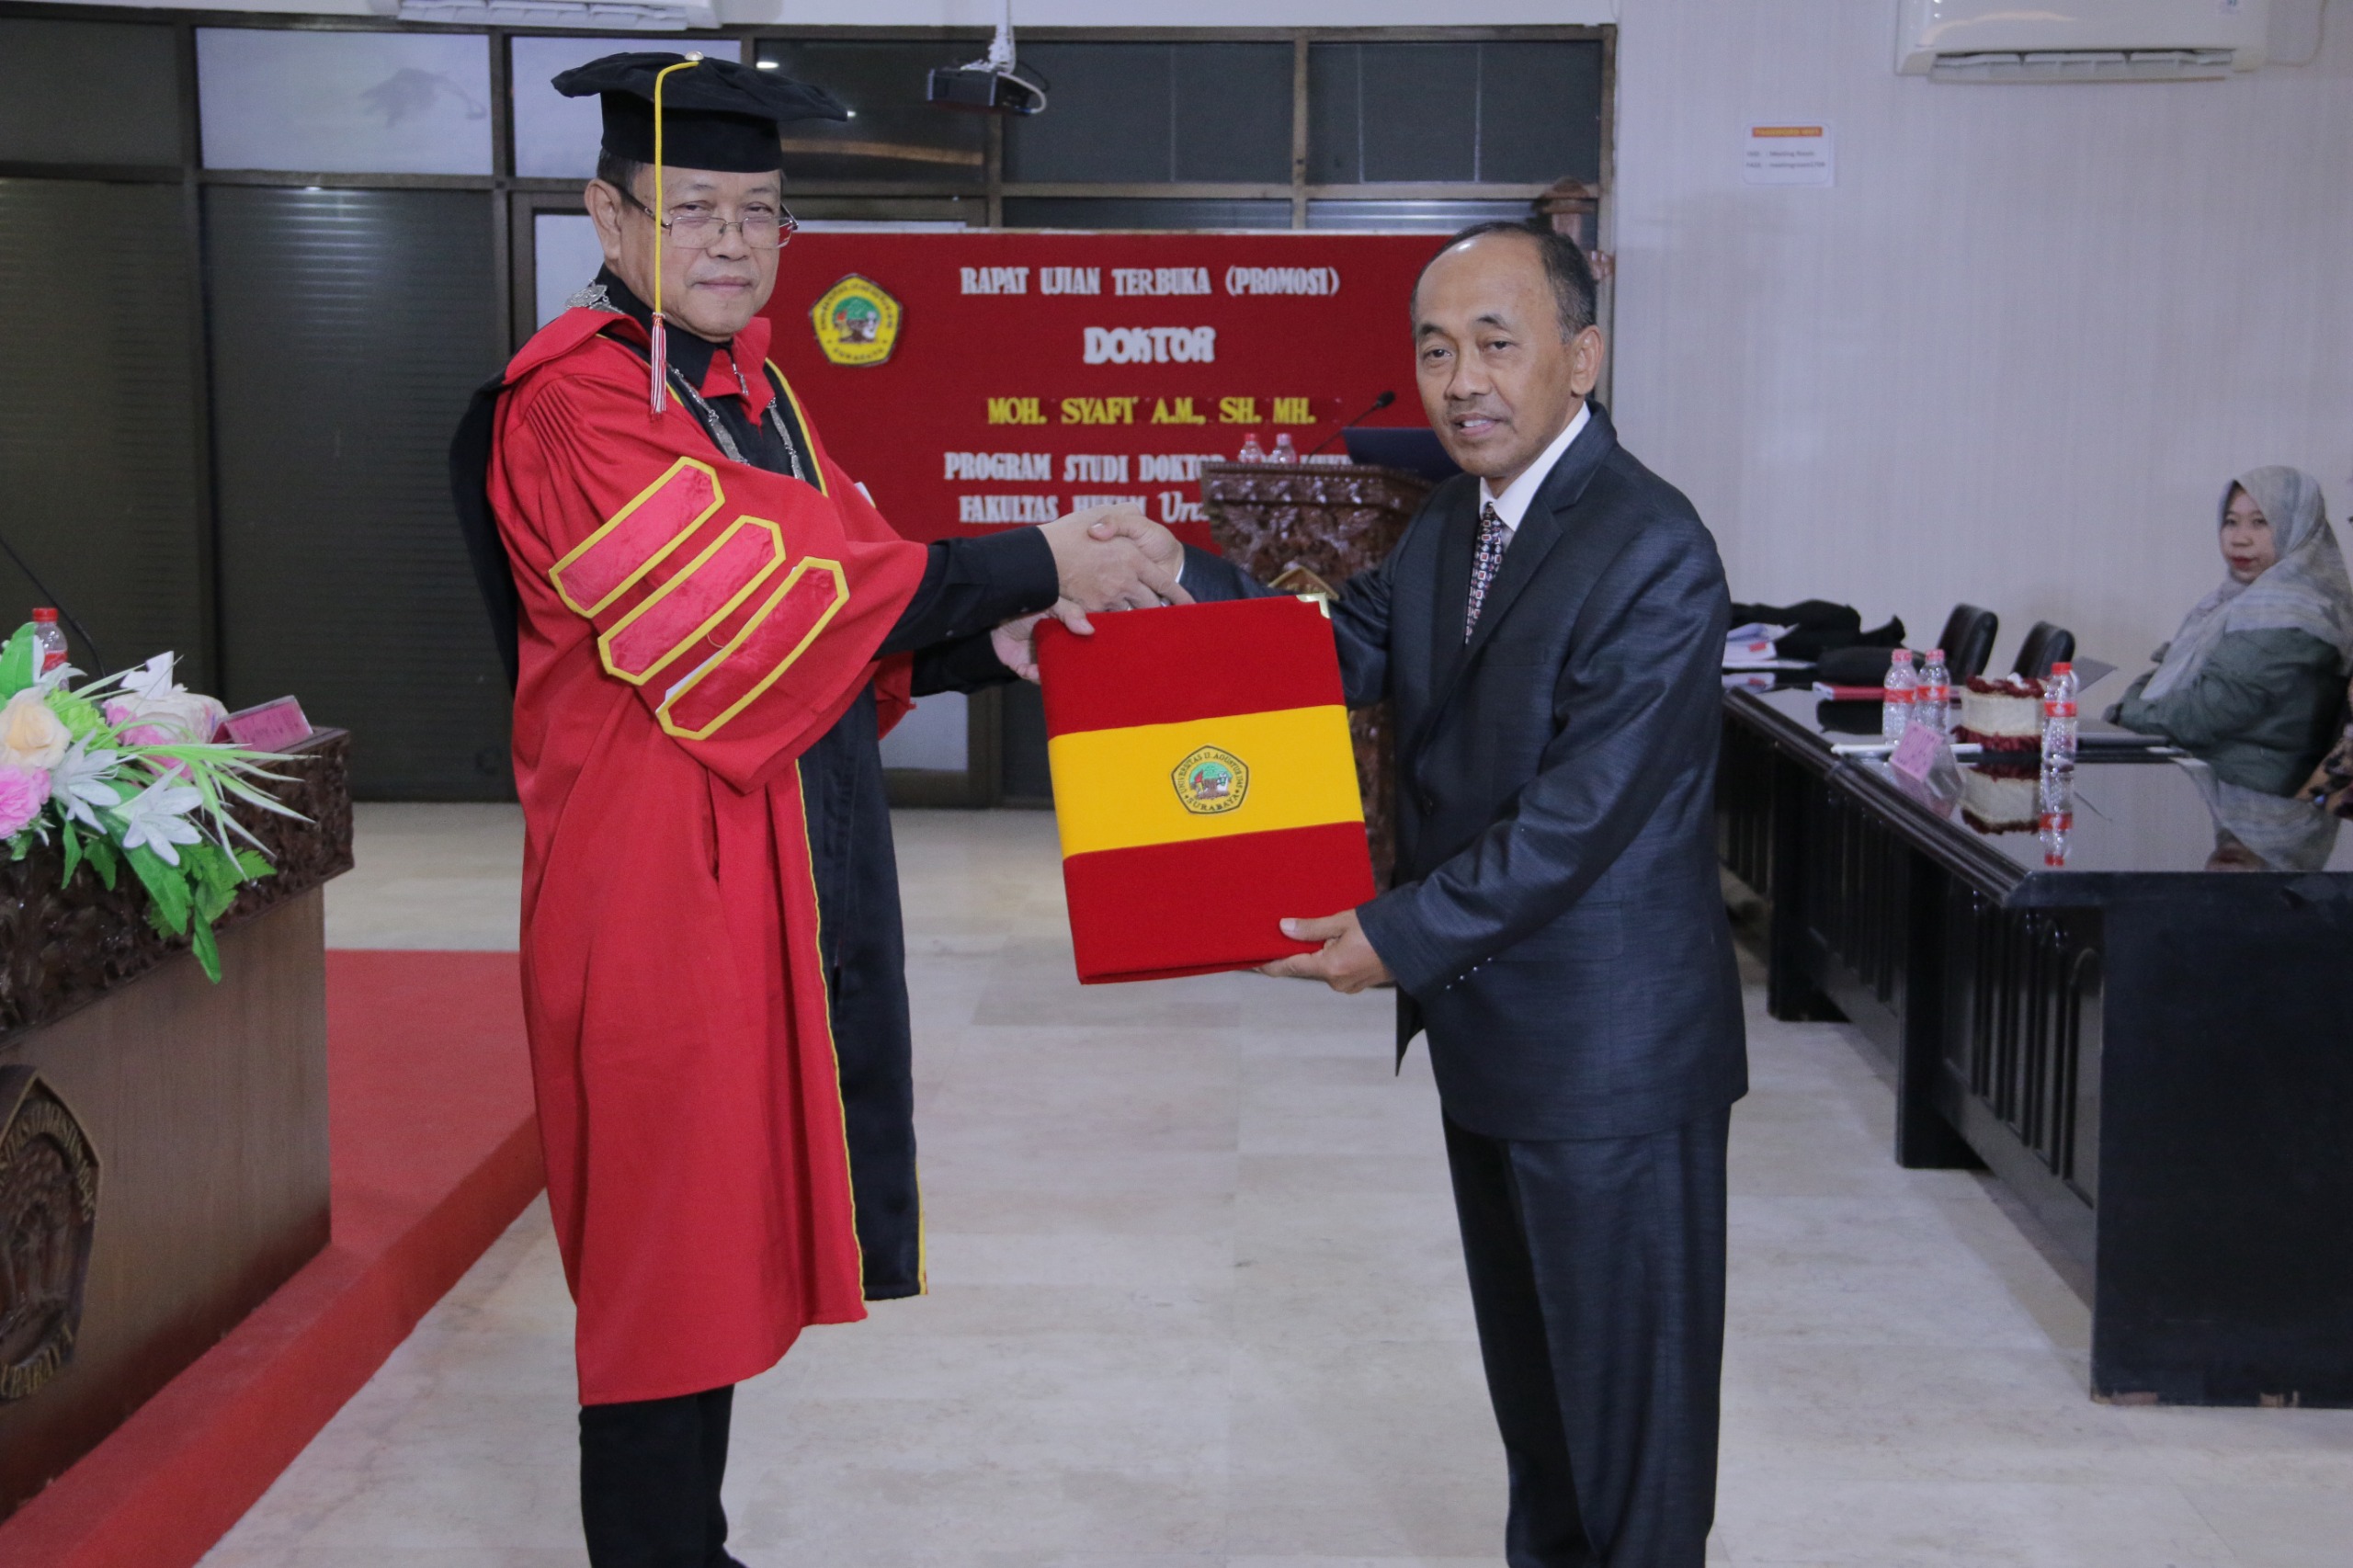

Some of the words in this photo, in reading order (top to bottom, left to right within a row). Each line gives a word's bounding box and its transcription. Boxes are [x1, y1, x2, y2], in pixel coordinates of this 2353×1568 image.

[961, 267, 1029, 295] RAPAT
[1040, 267, 1100, 295] UJIAN
[1111, 267, 1211, 296] TERBUKA
[1225, 265, 1339, 296] (PROMOSI)
[1083, 326, 1216, 364] DOKTOR
[988, 397, 1047, 425] MOH.
[1219, 396, 1262, 424] SH.
[1273, 396, 1316, 424] MH.
[944, 451, 1051, 481] PROGRAM
[1063, 454, 1130, 483] STUDI
[960, 494, 1059, 523] FAKULTAS
[1187, 795, 1240, 811] SURABAYA
